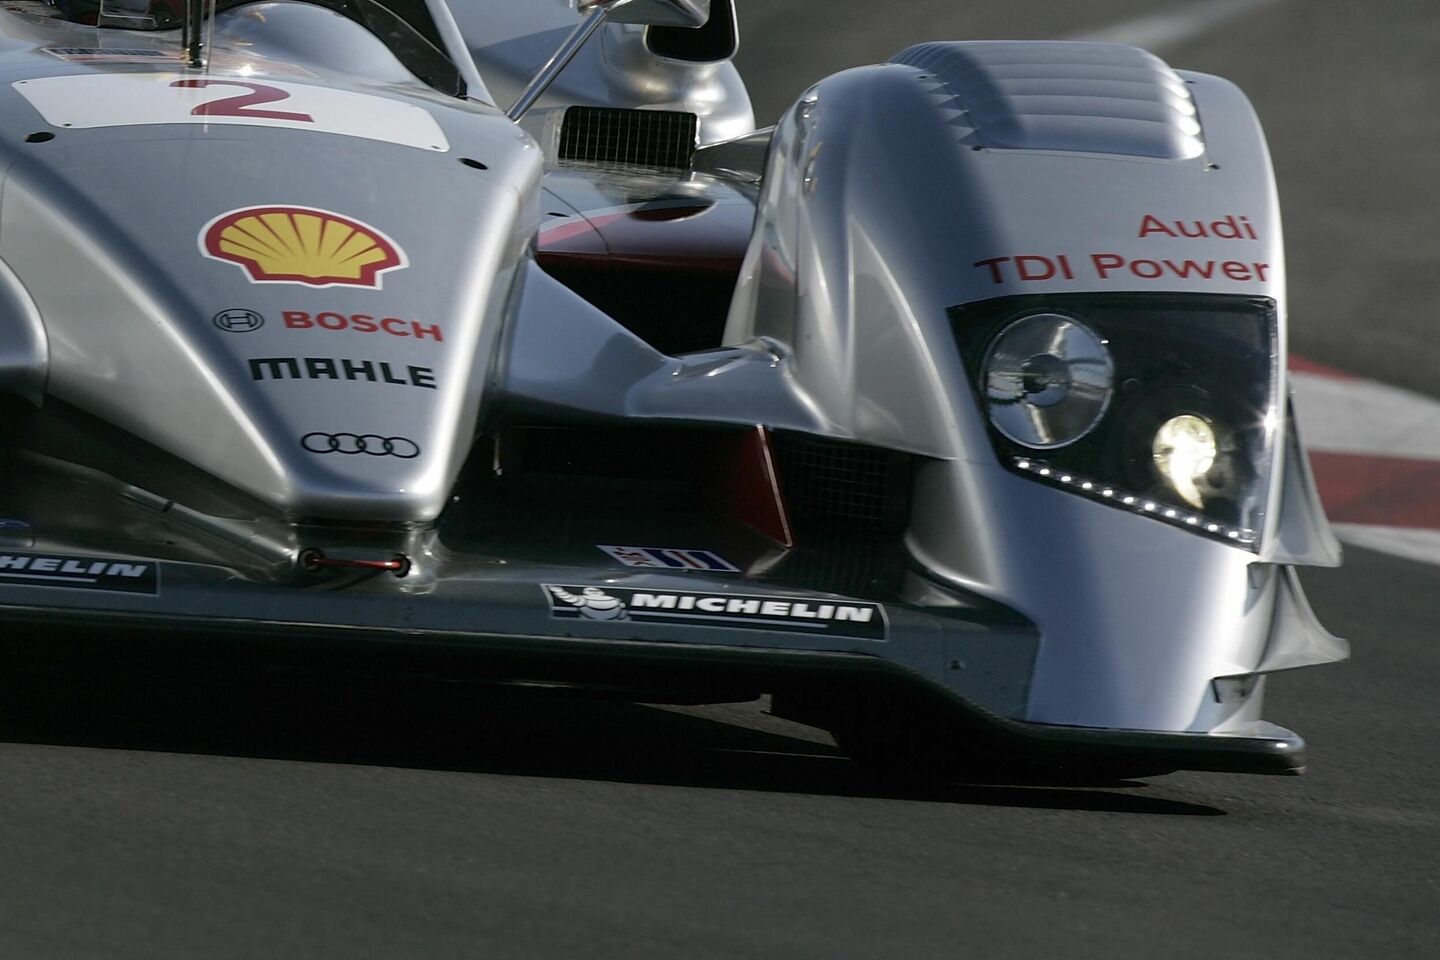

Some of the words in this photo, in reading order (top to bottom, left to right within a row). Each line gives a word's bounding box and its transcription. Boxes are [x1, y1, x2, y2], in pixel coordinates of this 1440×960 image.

[169, 79, 315, 123] 2
[1137, 214, 1258, 240] Audi
[973, 254, 1074, 284] TDI
[1090, 253, 1270, 282] Power
[282, 311, 443, 342] BOSCH
[248, 357, 437, 389] MAHLE
[631, 593, 873, 622] MICHELIN
